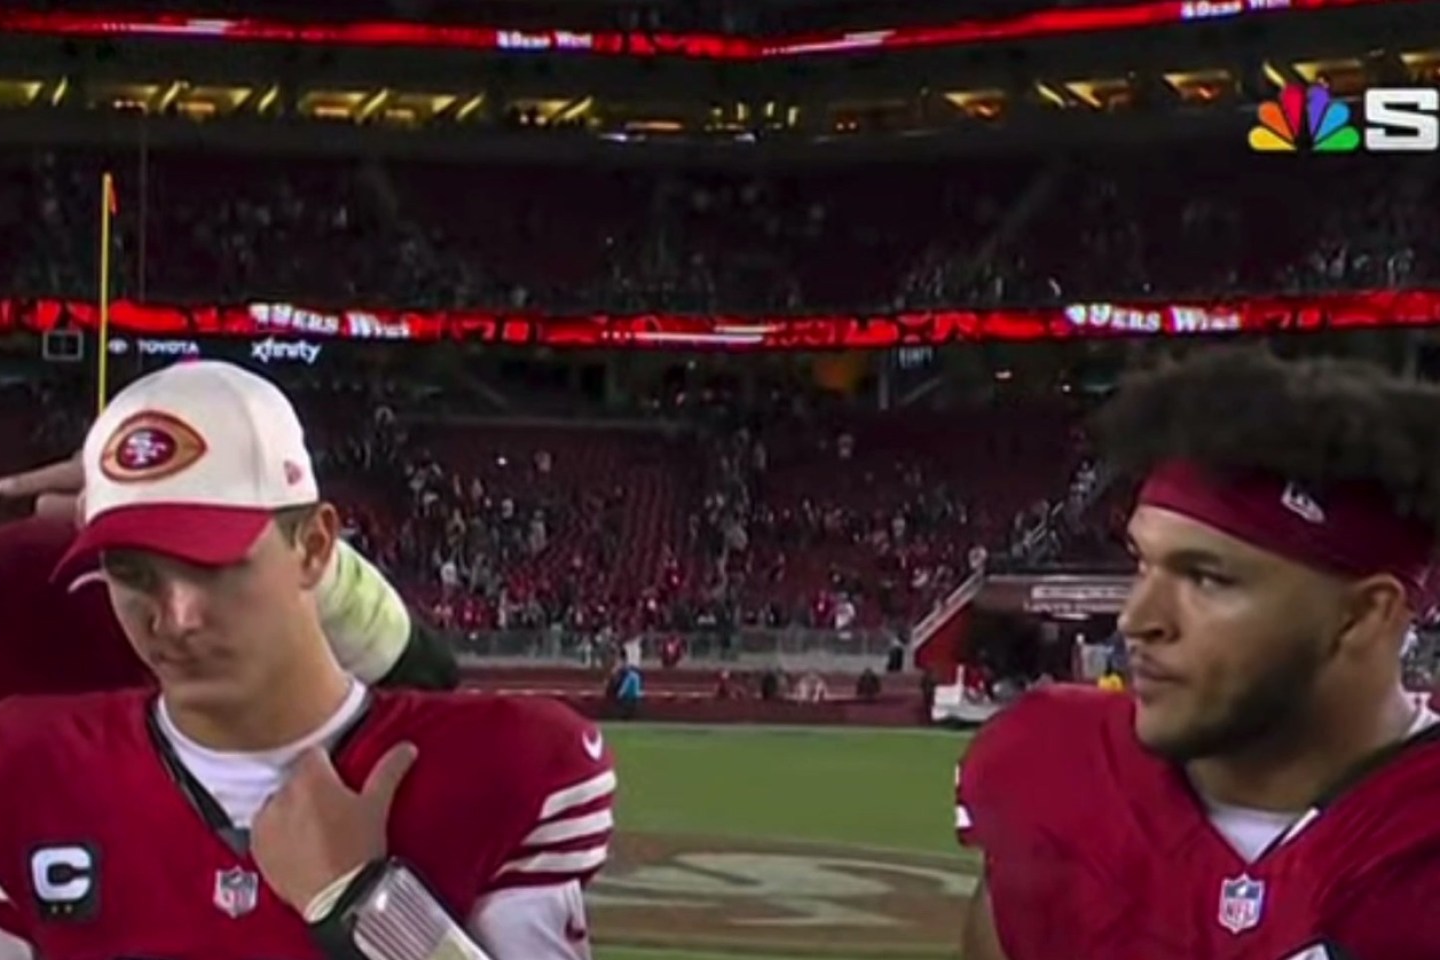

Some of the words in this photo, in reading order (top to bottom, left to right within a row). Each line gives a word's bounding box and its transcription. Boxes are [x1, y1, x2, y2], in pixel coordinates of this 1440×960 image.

[138, 340, 200, 354] TOYOTA
[250, 339, 322, 362] xfinity
[31, 847, 92, 901] C
